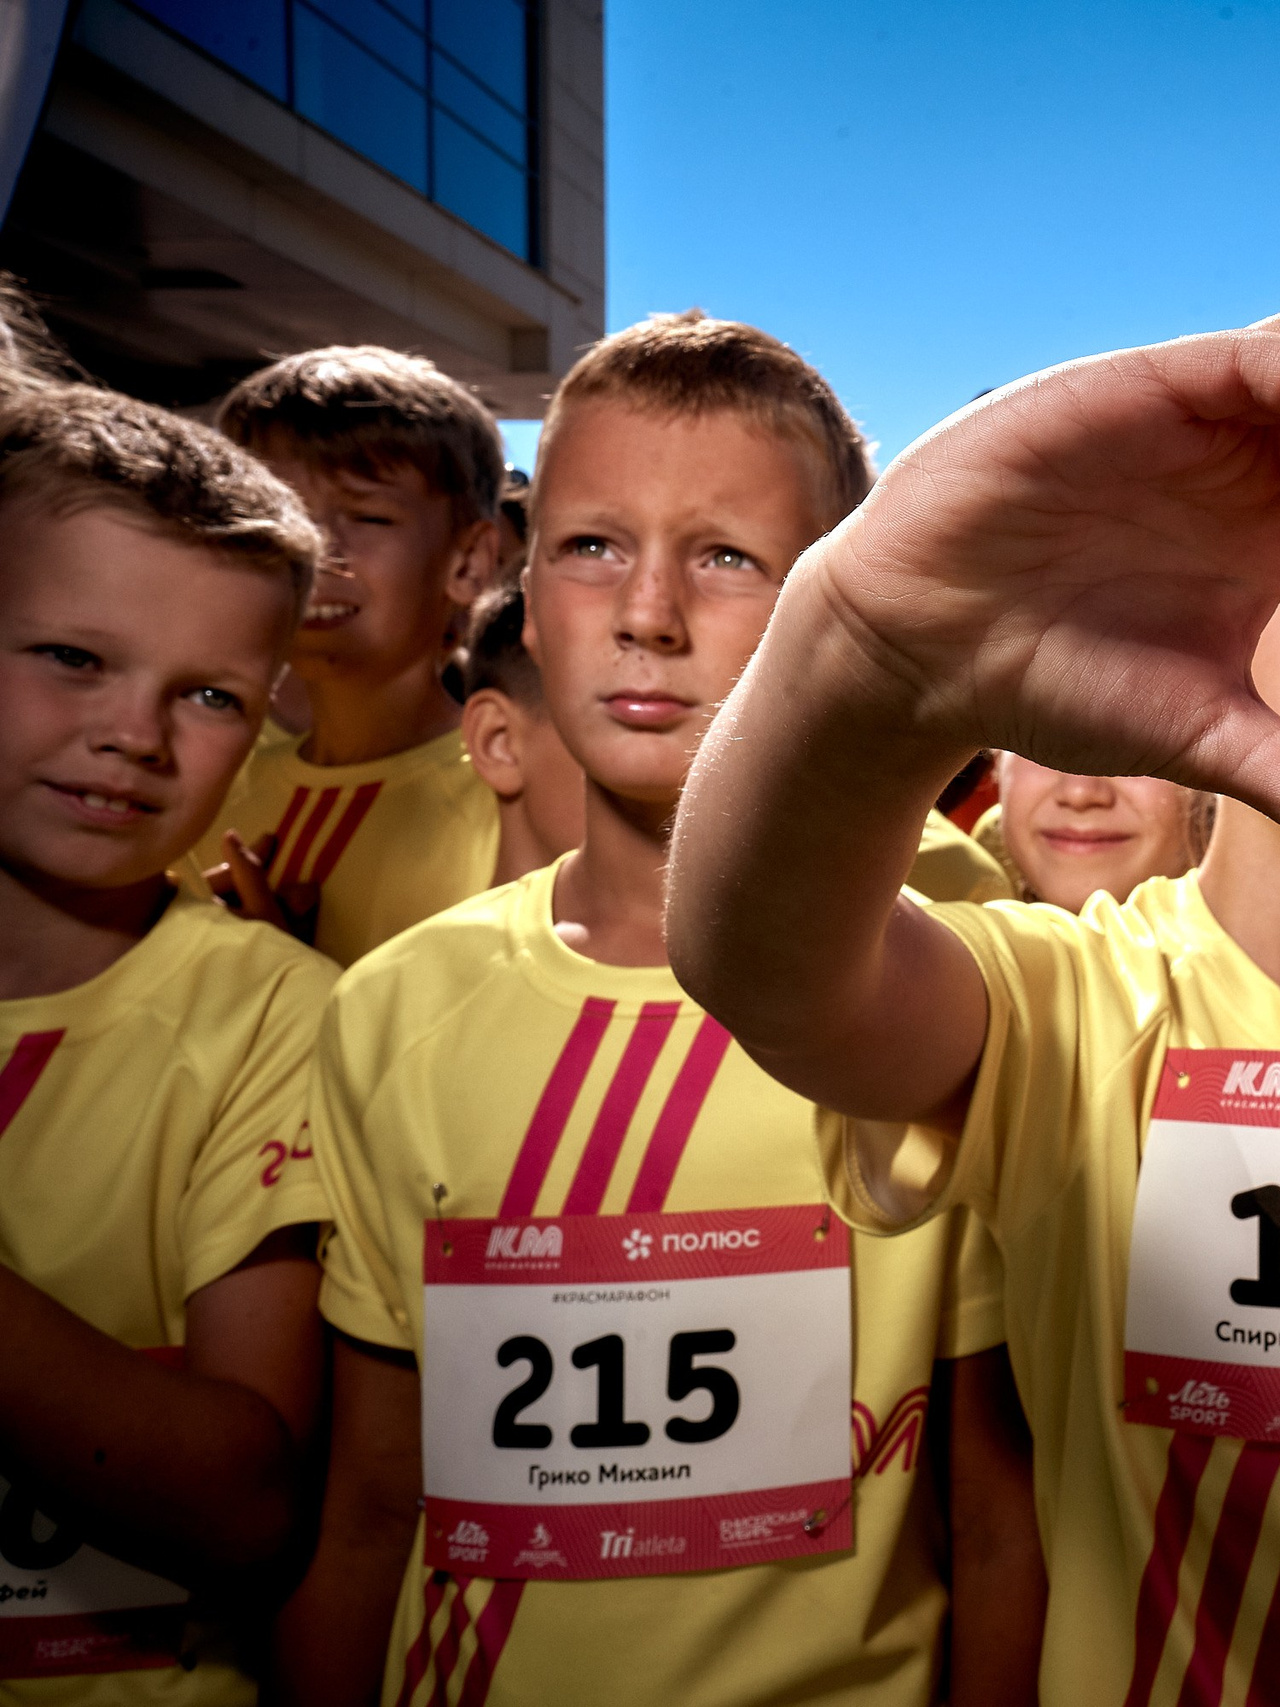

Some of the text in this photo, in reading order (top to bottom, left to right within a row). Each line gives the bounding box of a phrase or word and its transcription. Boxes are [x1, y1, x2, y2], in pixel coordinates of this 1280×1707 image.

[662, 1229, 761, 1253] ПОЛЮС
[552, 1289, 670, 1305] #КРАСМАРАФОН
[493, 1330, 740, 1448] 215
[1169, 1404, 1231, 1427] SPORT
[529, 1463, 691, 1490] Грико Михаил
[449, 1544, 490, 1563] SPORT
